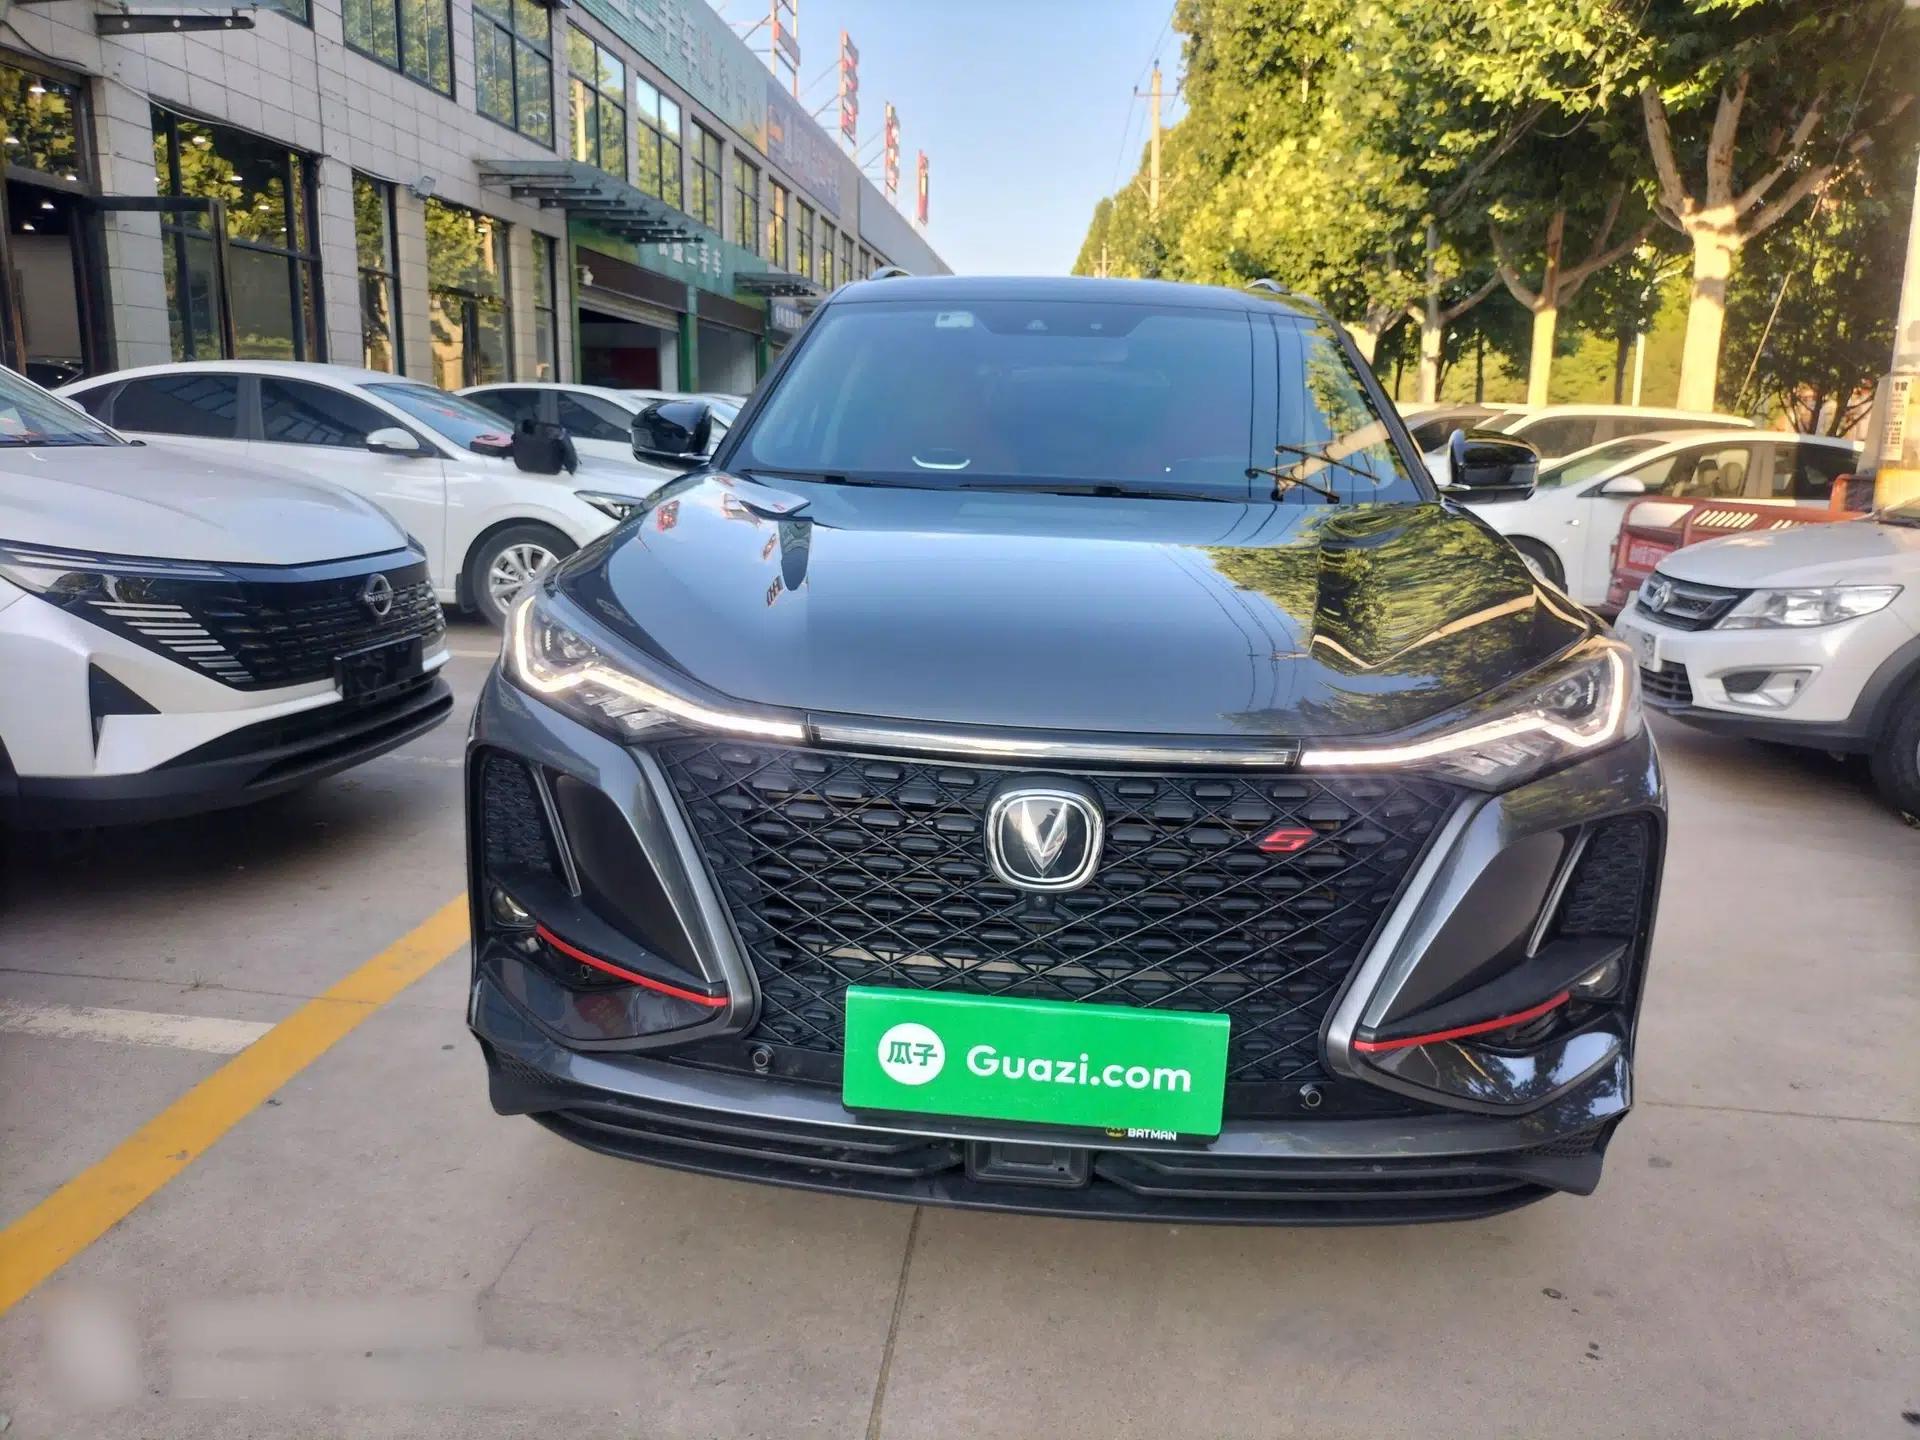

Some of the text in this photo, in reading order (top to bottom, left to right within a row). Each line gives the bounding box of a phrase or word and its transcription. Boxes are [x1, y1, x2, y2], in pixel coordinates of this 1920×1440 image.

[887, 1041, 938, 1066] 瓜子
[966, 1044, 1192, 1093] Guazi.com
[1127, 1127, 1177, 1141] BATMAN
